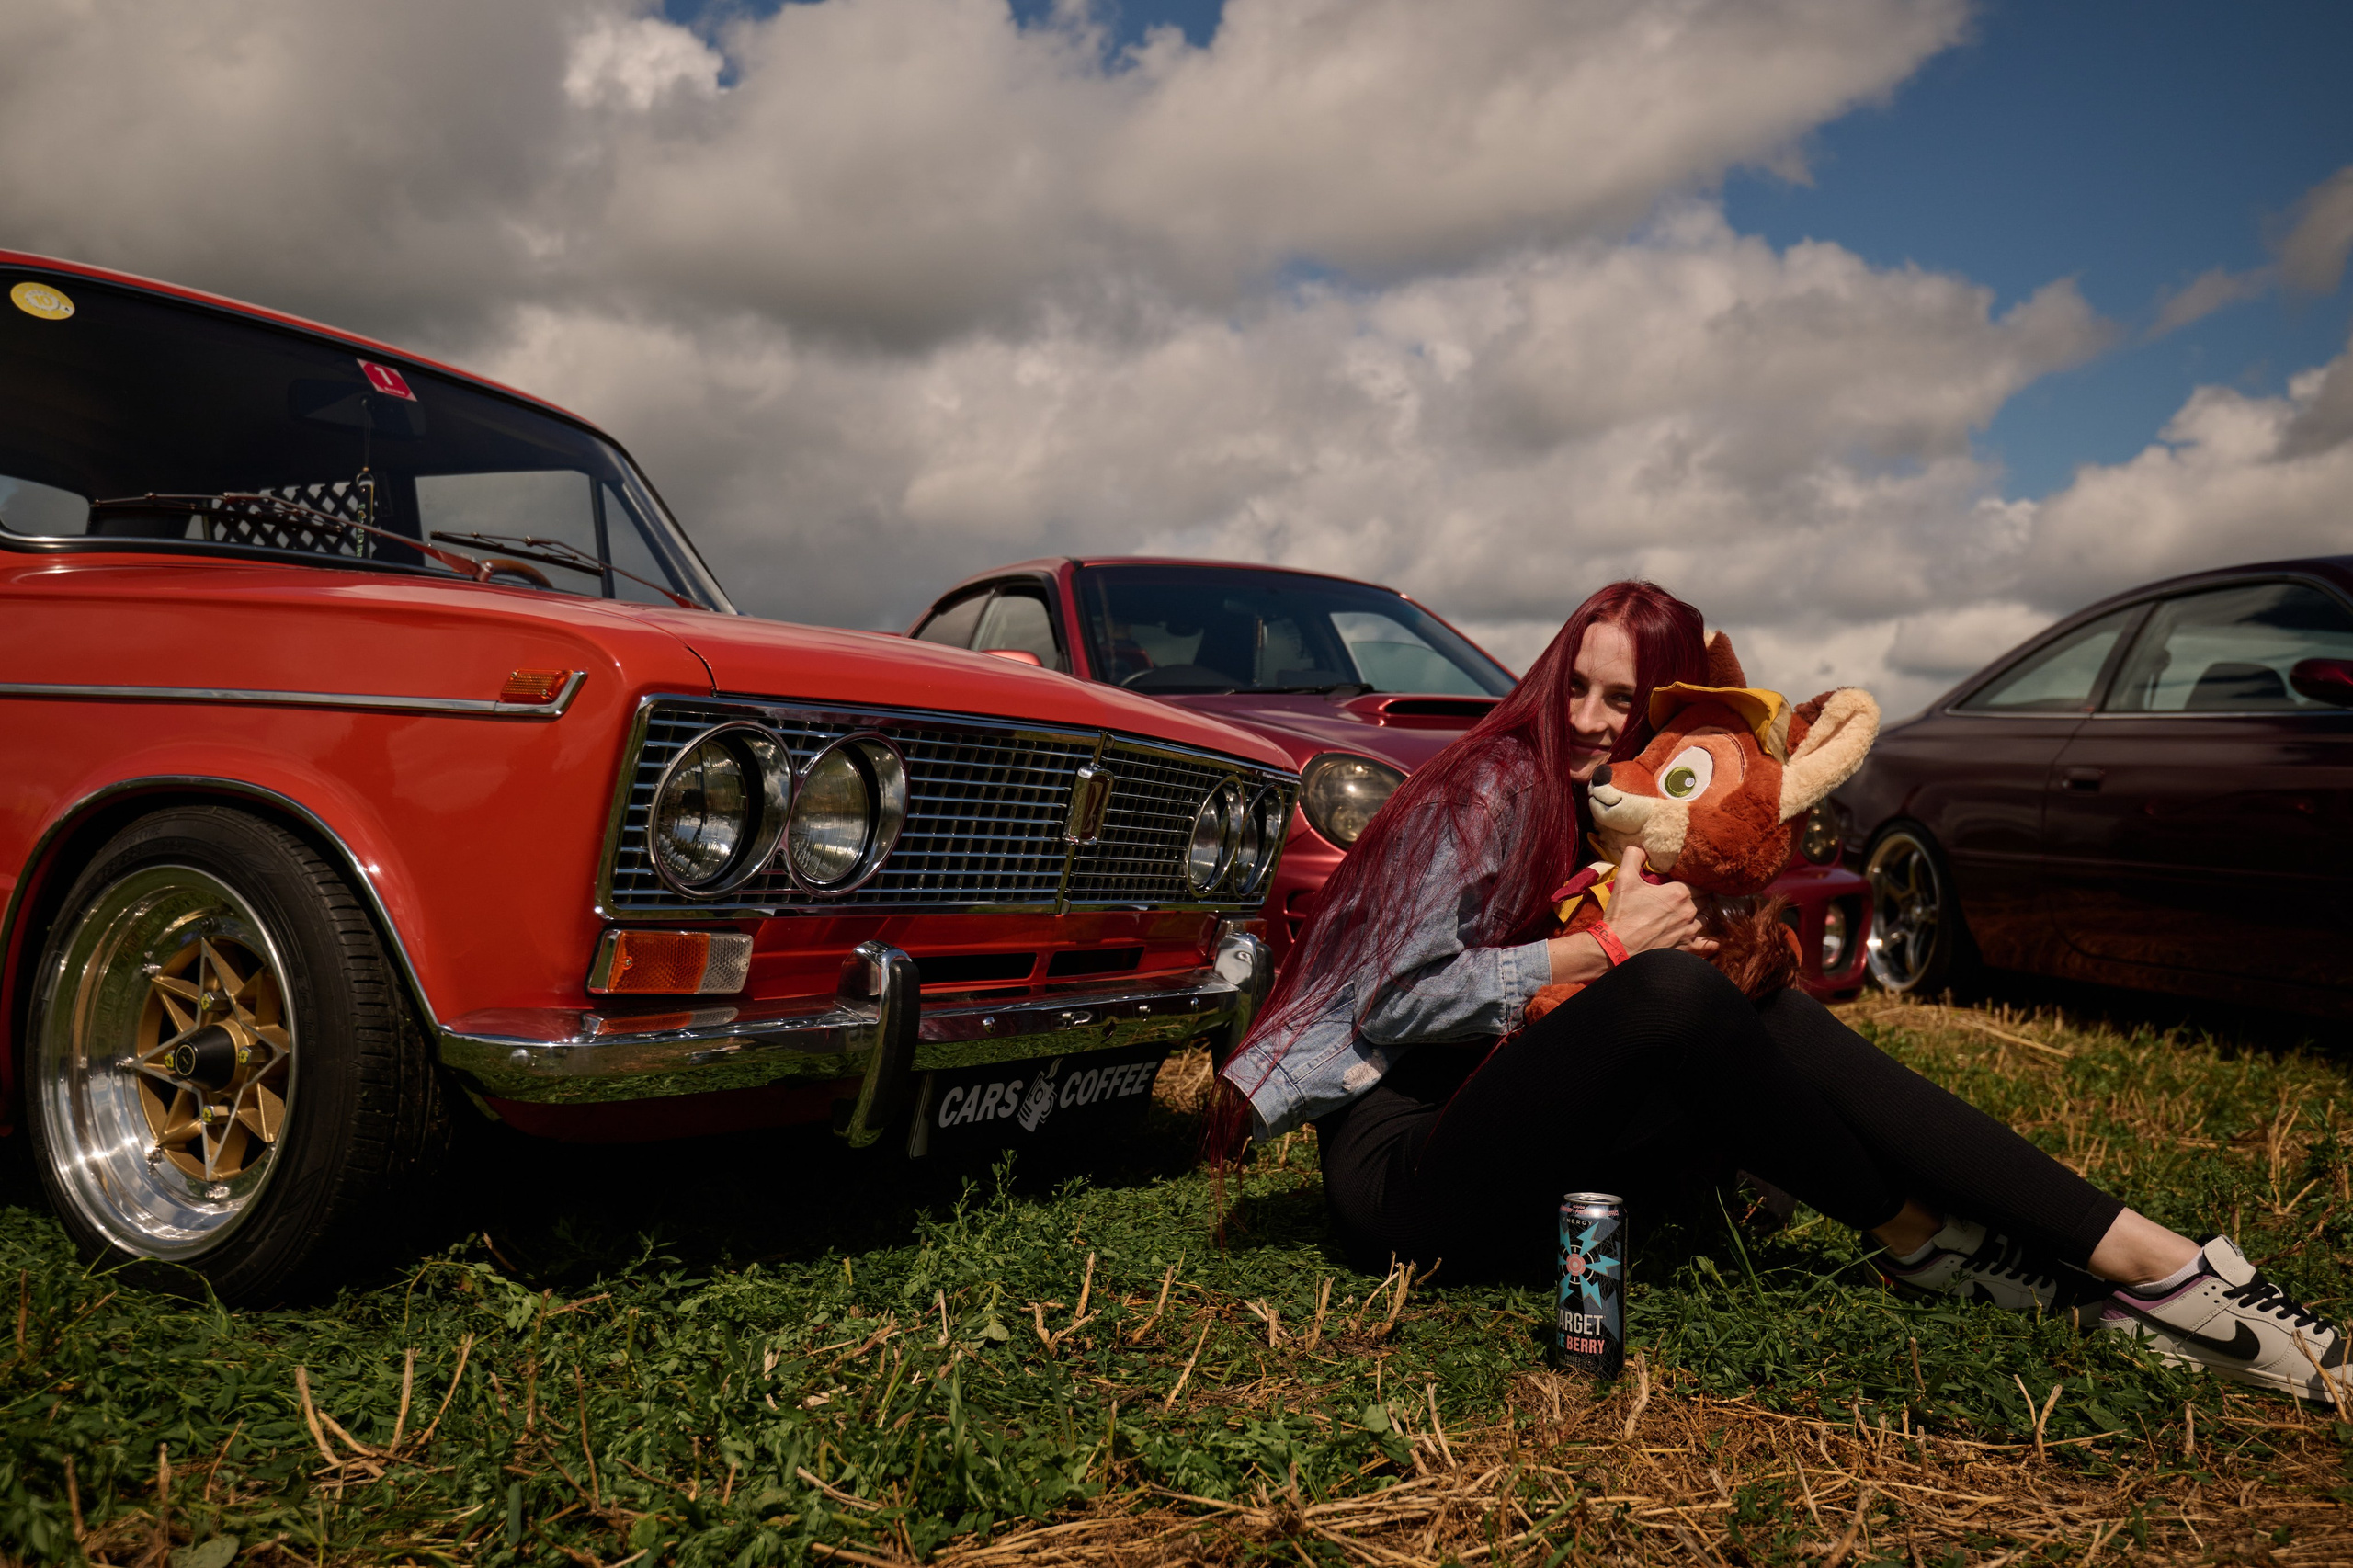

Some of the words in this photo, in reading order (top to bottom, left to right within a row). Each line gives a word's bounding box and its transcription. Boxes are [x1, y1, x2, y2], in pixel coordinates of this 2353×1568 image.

[373, 366, 394, 386] 1
[938, 1079, 1024, 1128] CARS
[1059, 1061, 1159, 1109] COFFEE
[1563, 1217, 1593, 1226] ENERGY
[1557, 1308, 1604, 1335] ARGET
[1566, 1335, 1605, 1355] BERRY
